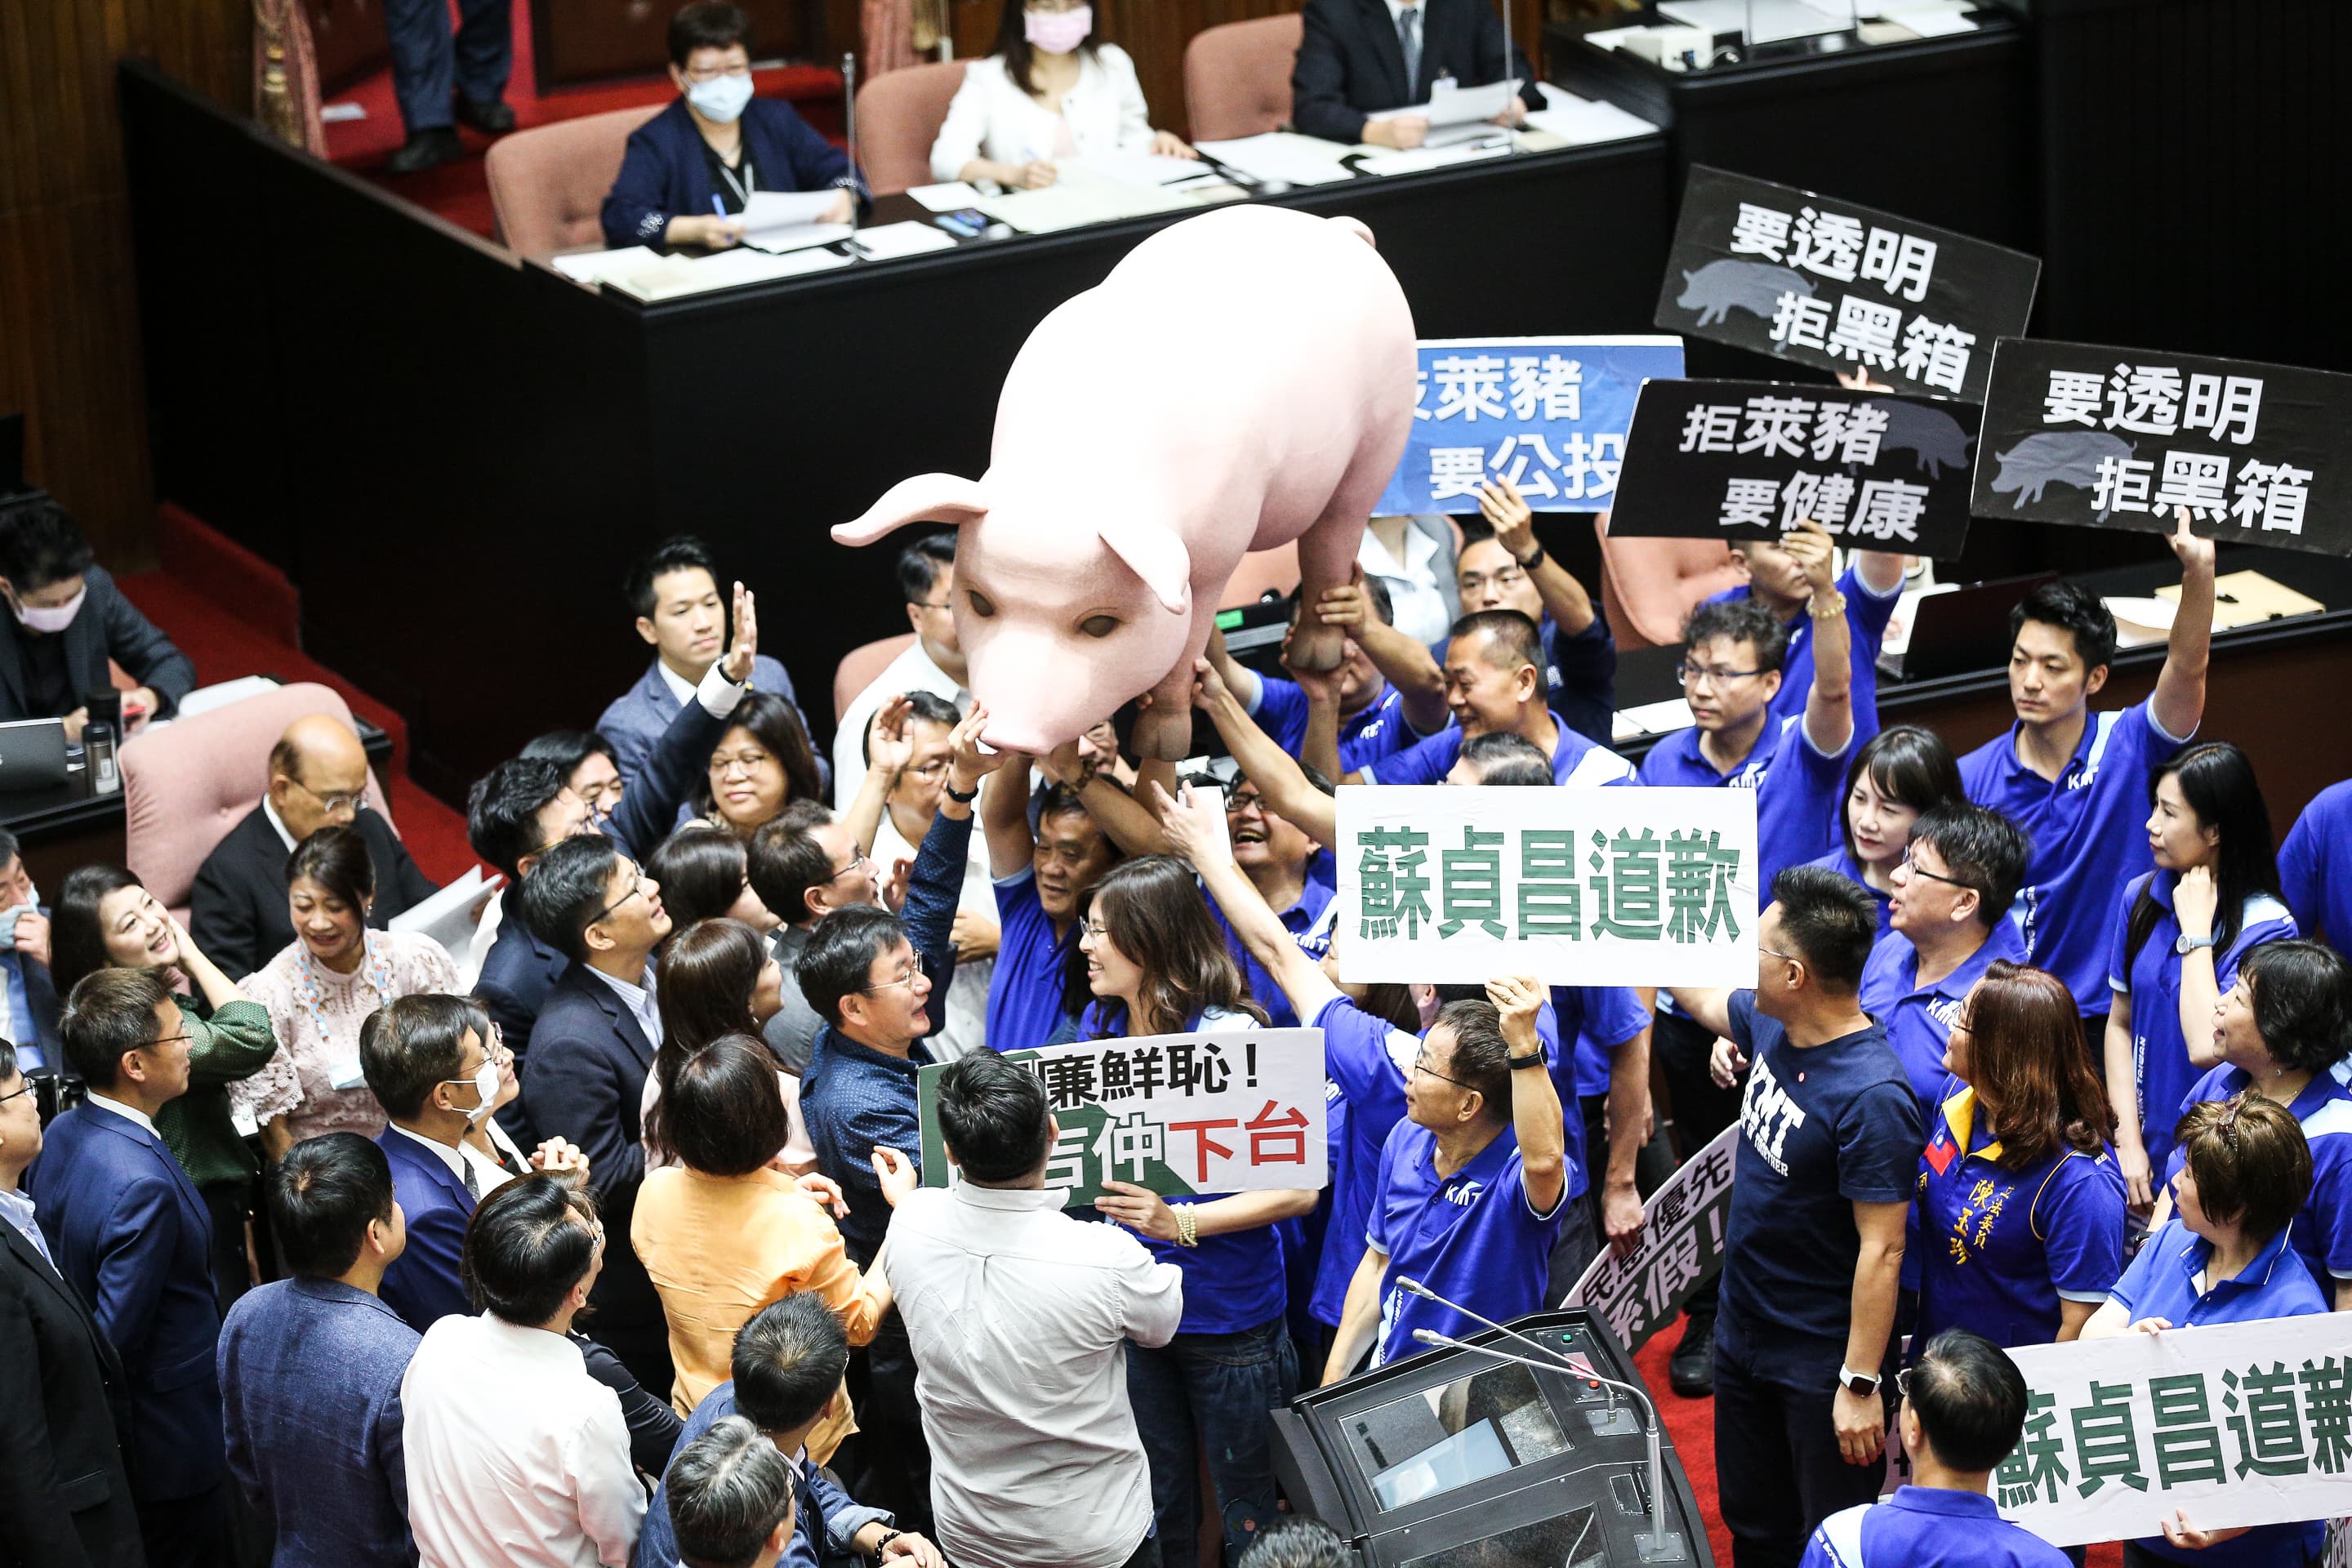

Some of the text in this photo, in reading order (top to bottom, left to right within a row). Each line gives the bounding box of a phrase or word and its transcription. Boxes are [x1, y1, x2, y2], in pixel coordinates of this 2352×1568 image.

[1729, 202, 1938, 303] 要透明
[1768, 290, 1976, 394] 拒黑箱
[1679, 396, 1890, 467] 拒萊豬
[2042, 363, 2264, 445] 要透明
[1429, 432, 1624, 500] 要公投
[1718, 470, 1930, 544] 要健康
[2091, 450, 2313, 535] 拒黑箱
[1357, 826, 1740, 944] 蘇貞昌道歉
[1018, 1043, 1257, 1109] 廉鮮恥！
[1973, 1185, 2015, 1250] 立法委員
[1998, 1356, 2352, 1509] 蘇貞昌道歉
